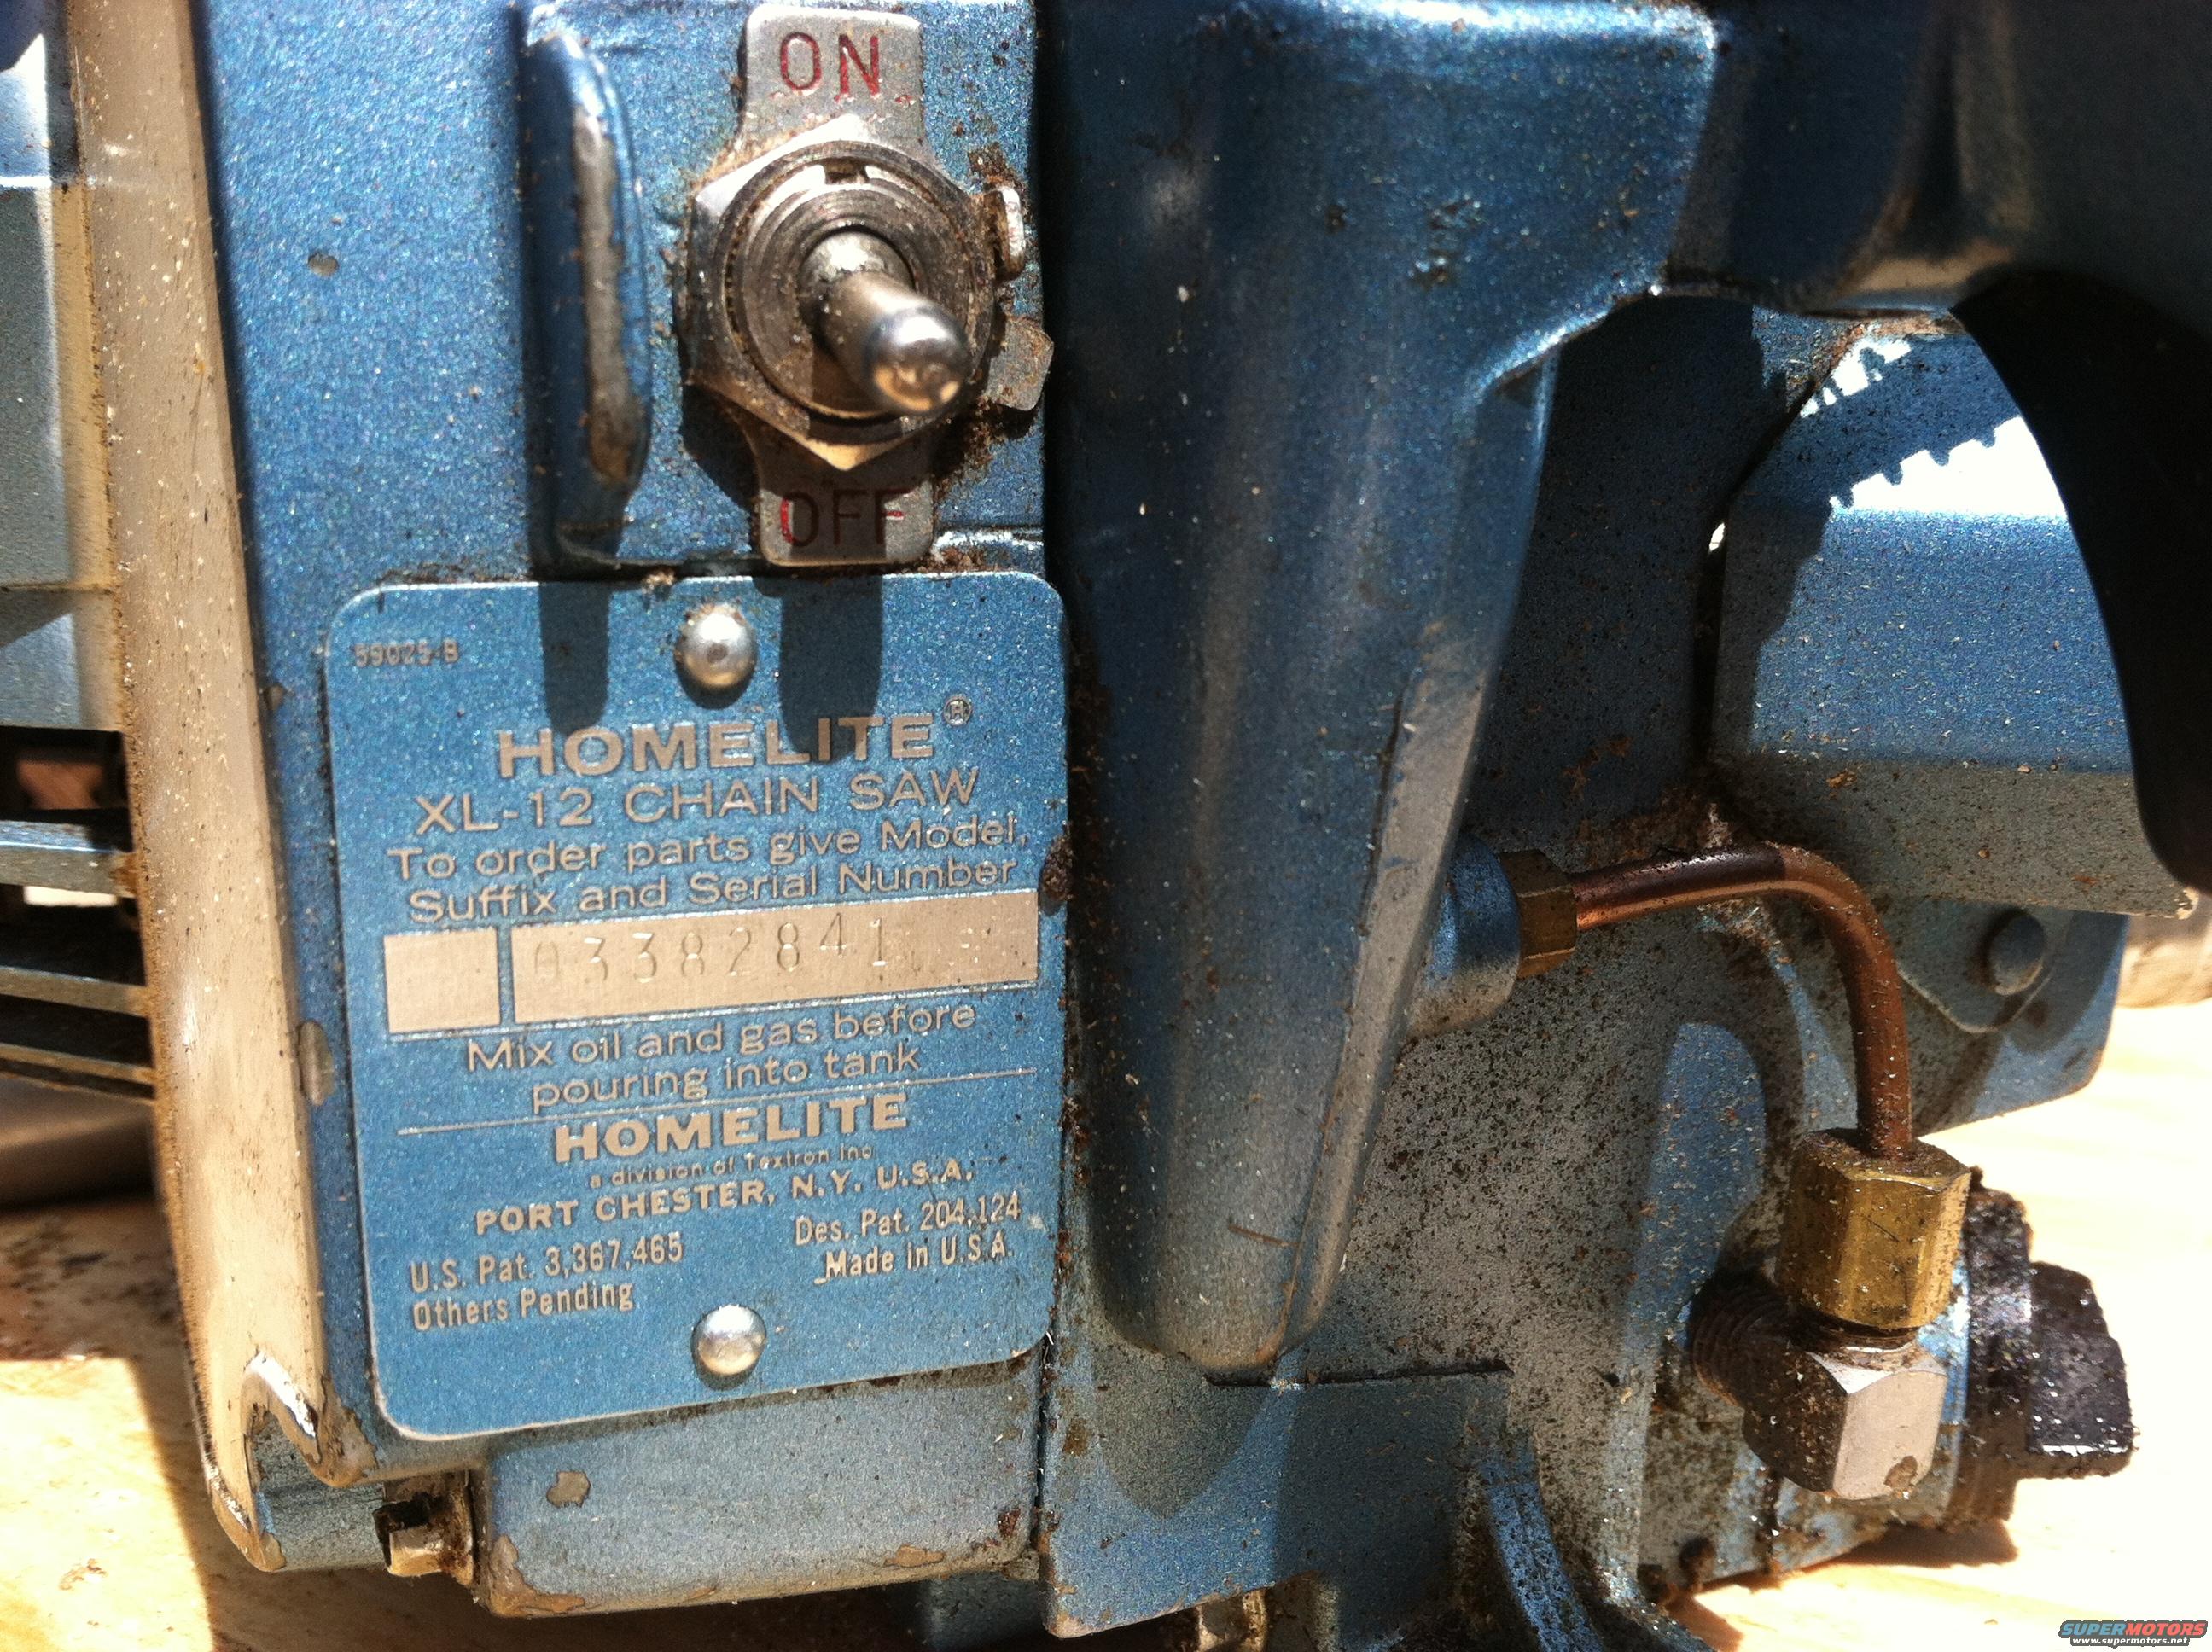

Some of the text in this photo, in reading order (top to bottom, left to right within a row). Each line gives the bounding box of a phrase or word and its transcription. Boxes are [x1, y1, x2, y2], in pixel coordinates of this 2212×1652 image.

[780, 32, 880, 96] ON
[780, 489, 911, 547] OFF
[416, 766, 980, 835] XL-12 CHAIN SAW
[387, 815, 1027, 881] To order parts give Model,
[410, 854, 1018, 923] Suffix and Serial Number
[469, 1003, 976, 1072] Mix oil and gas before
[533, 1042, 920, 1115] pouring into tank
[555, 1092, 907, 1164] HOMELITE
[612, 1160, 703, 1187] division
[713, 1157, 735, 1175] of
[475, 1200, 579, 1236] PORT
[596, 1179, 776, 1222] CHESTER,
[795, 1216, 850, 1246] Des.
[861, 1208, 909, 1236] Pat.
[410, 1230, 684, 1293] U.S. Pat. 3,367,465
[825, 1246, 894, 1278] Made
[907, 1242, 928, 1270] in
[413, 1281, 634, 1331] Others Pending
